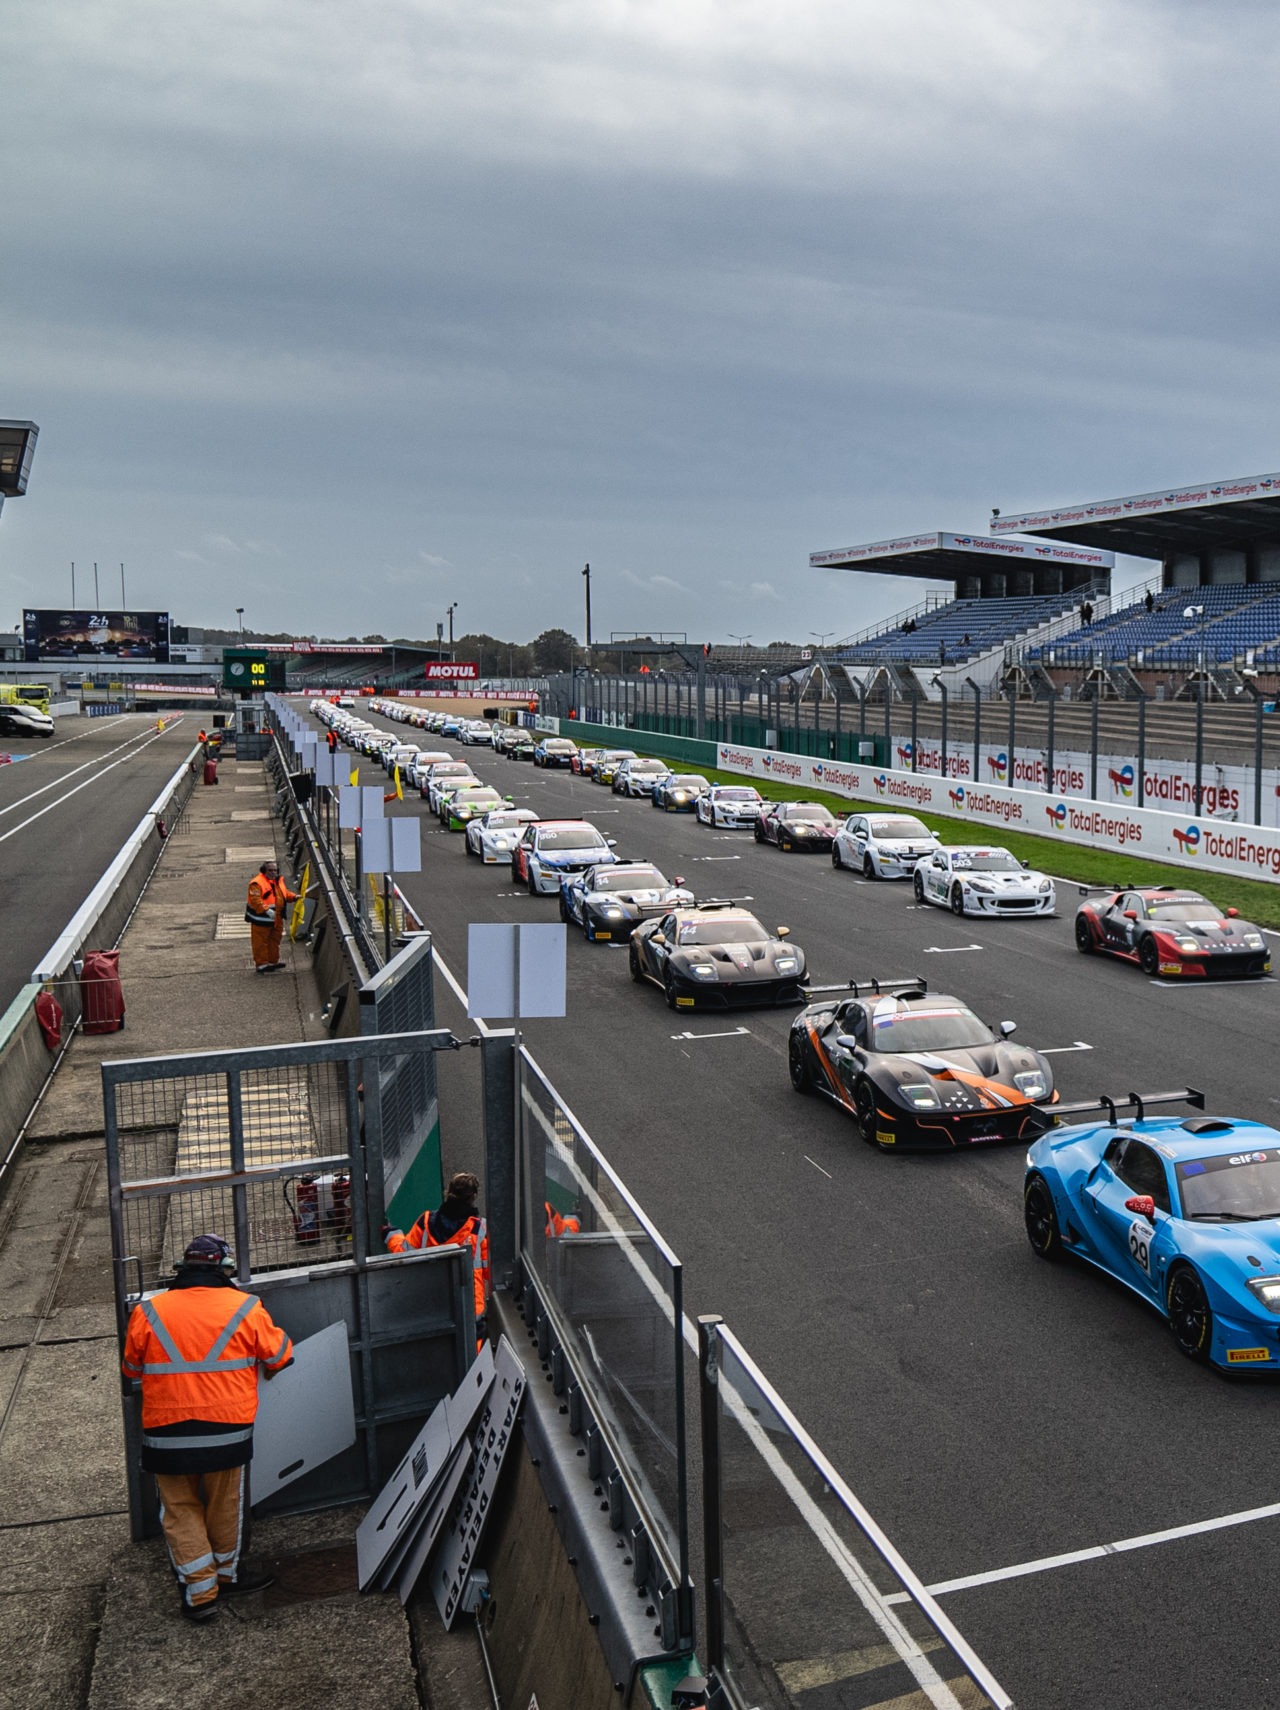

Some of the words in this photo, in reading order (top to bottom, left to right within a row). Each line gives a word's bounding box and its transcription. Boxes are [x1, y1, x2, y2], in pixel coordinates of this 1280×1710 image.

[972, 540, 1024, 553] TotalEnergies
[1052, 549, 1102, 562] TotalEnergies
[428, 665, 475, 677] MOTUL
[772, 758, 802, 779] TotalEnergies
[823, 767, 860, 790] TotalEnergies
[887, 778, 932, 804] TotalEnergies
[966, 791, 1022, 820] TotalEnergies
[1069, 808, 1142, 844] TotalEnergies
[1229, 1154, 1252, 1165] elf
[1131, 1235, 1148, 1270] 29
[1230, 1350, 1266, 1360] PIRELLI
[493, 1378, 522, 1472] START
[460, 1427, 497, 1543] DEPART
[446, 1490, 489, 1621] DELAYED
